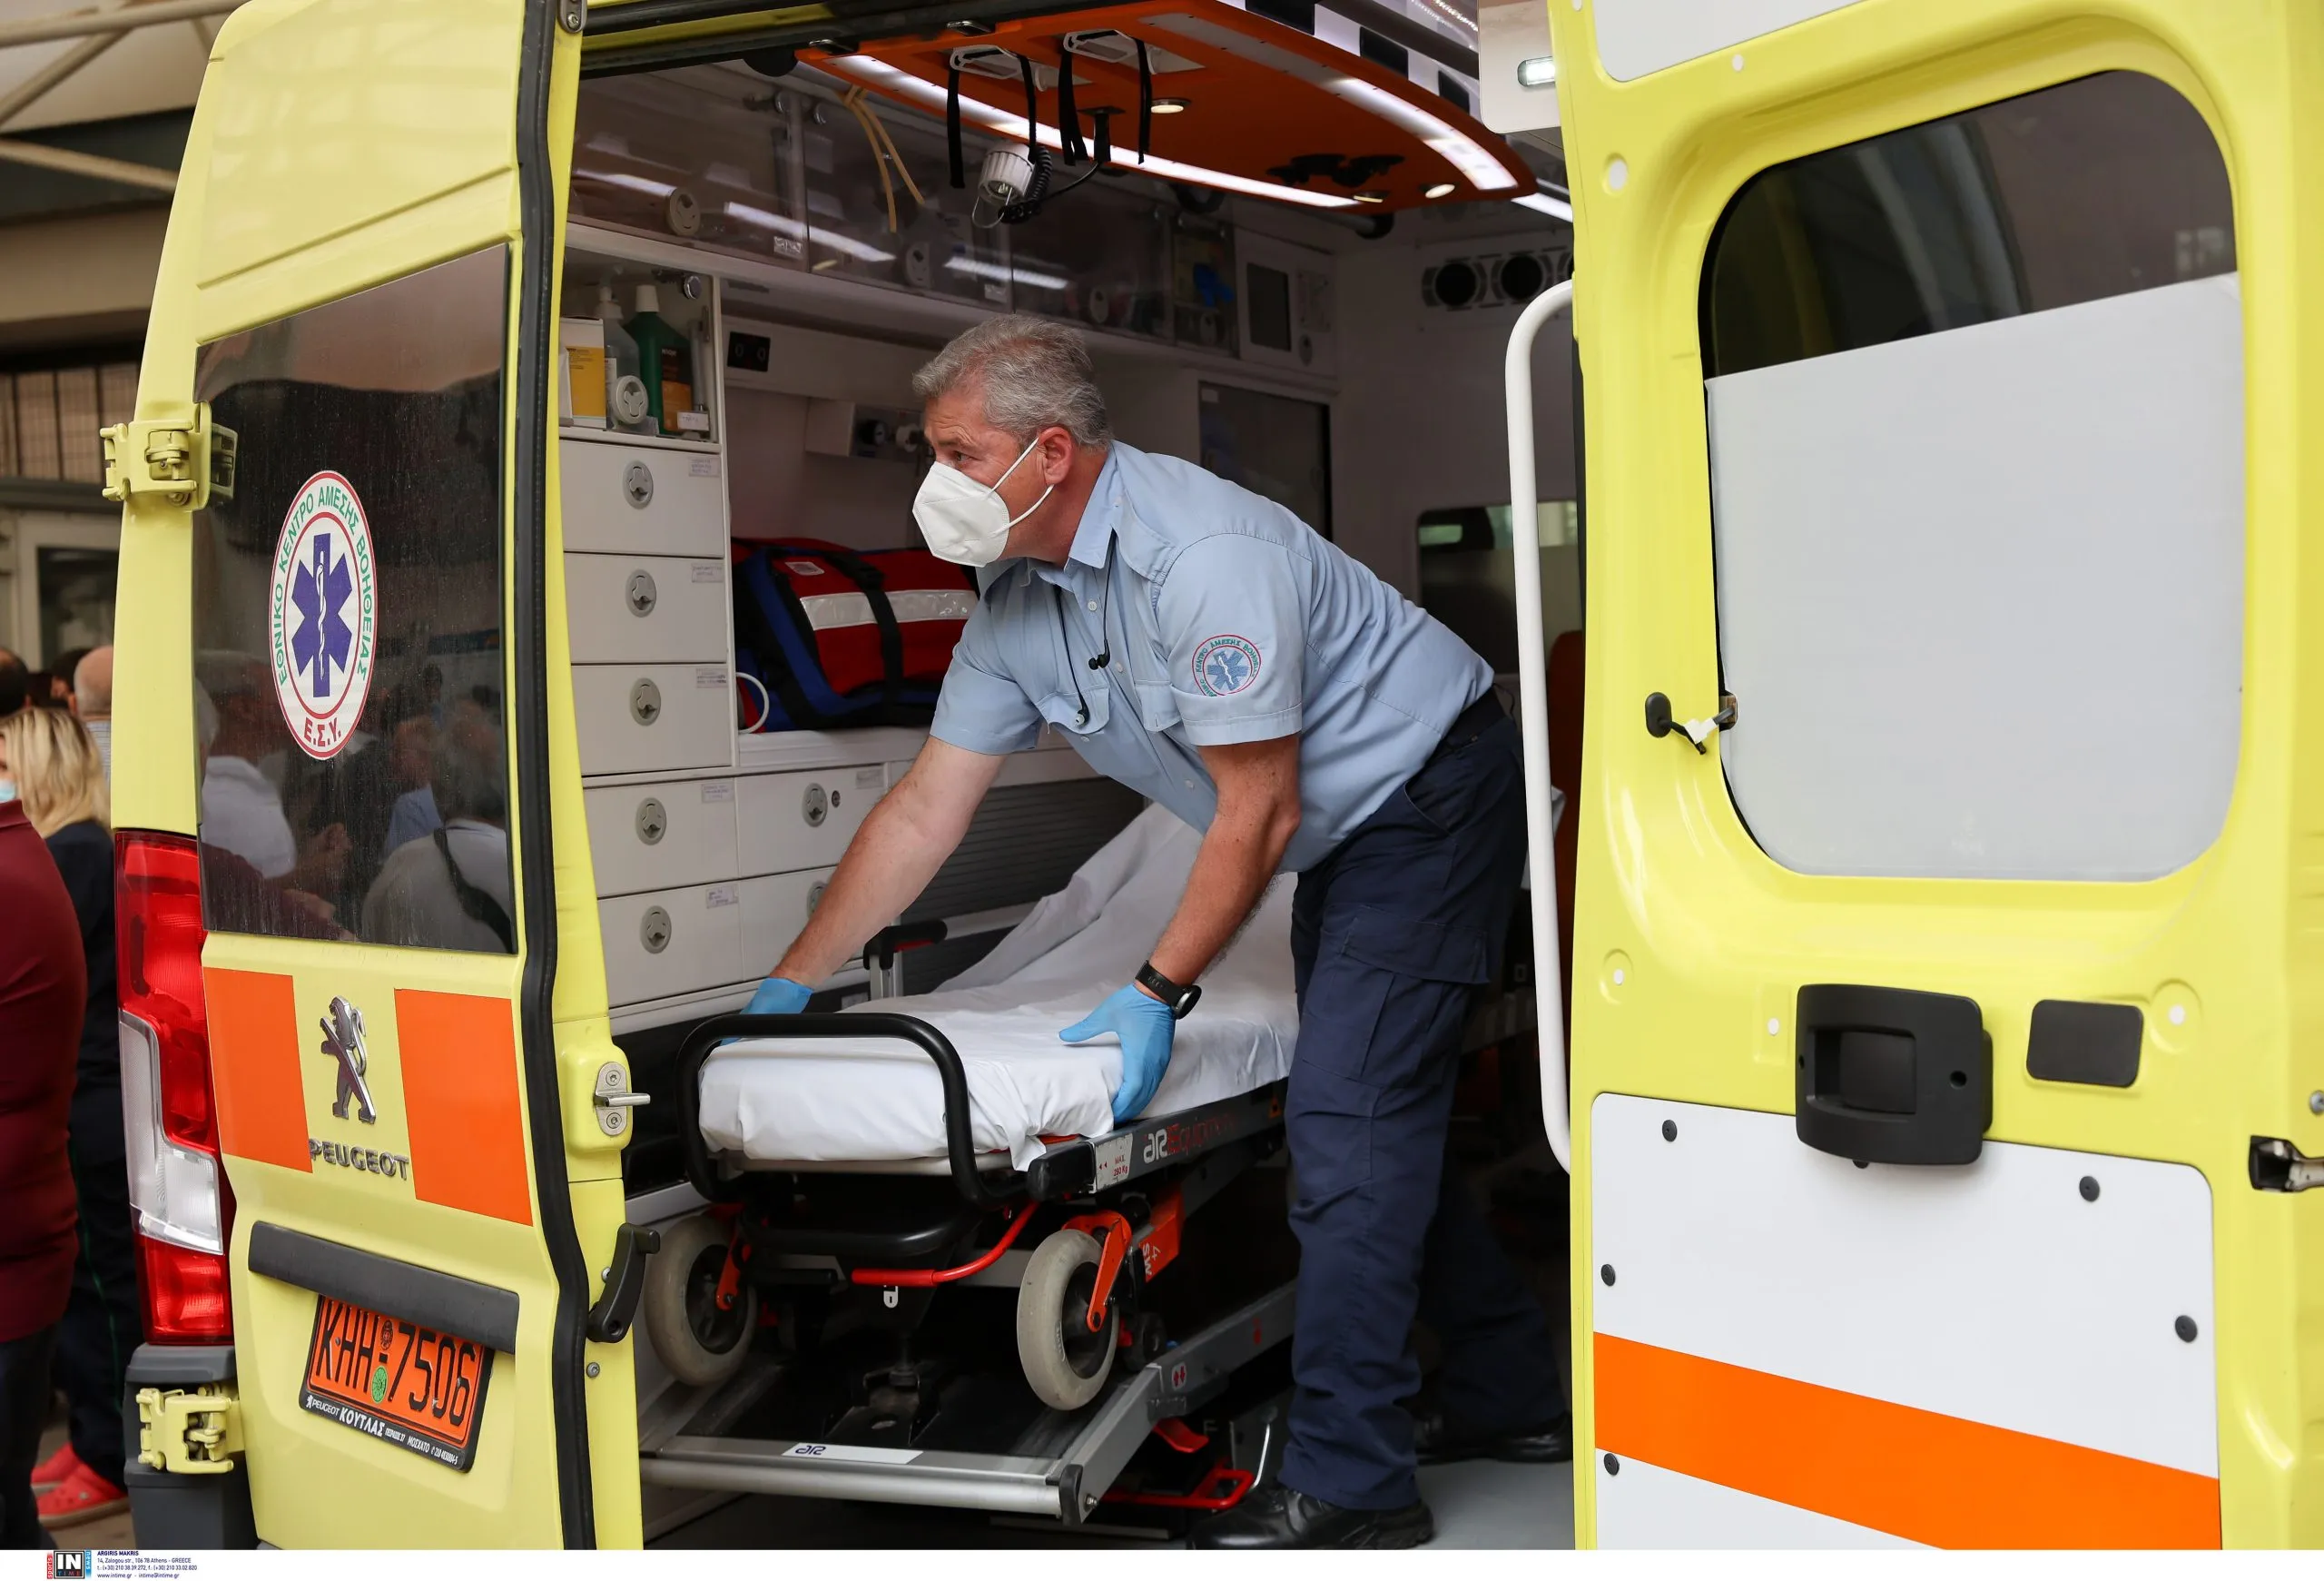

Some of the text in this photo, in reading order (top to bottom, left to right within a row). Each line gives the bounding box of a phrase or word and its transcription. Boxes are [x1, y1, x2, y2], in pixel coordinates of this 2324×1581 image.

[273, 485, 373, 687] ΕΘΝΙΚΟ ΚΕΝΤΡΟ ΑΜΕΣΗΣ ΒΟΗΘΕΙΑΣ
[303, 716, 342, 748] Ε.Σ.Υ.
[308, 1138, 409, 1181] PEUGEOT
[311, 1398, 340, 1417] PEUGEOT
[339, 1406, 386, 1438] ΚΟΥΤΛΑΣ
